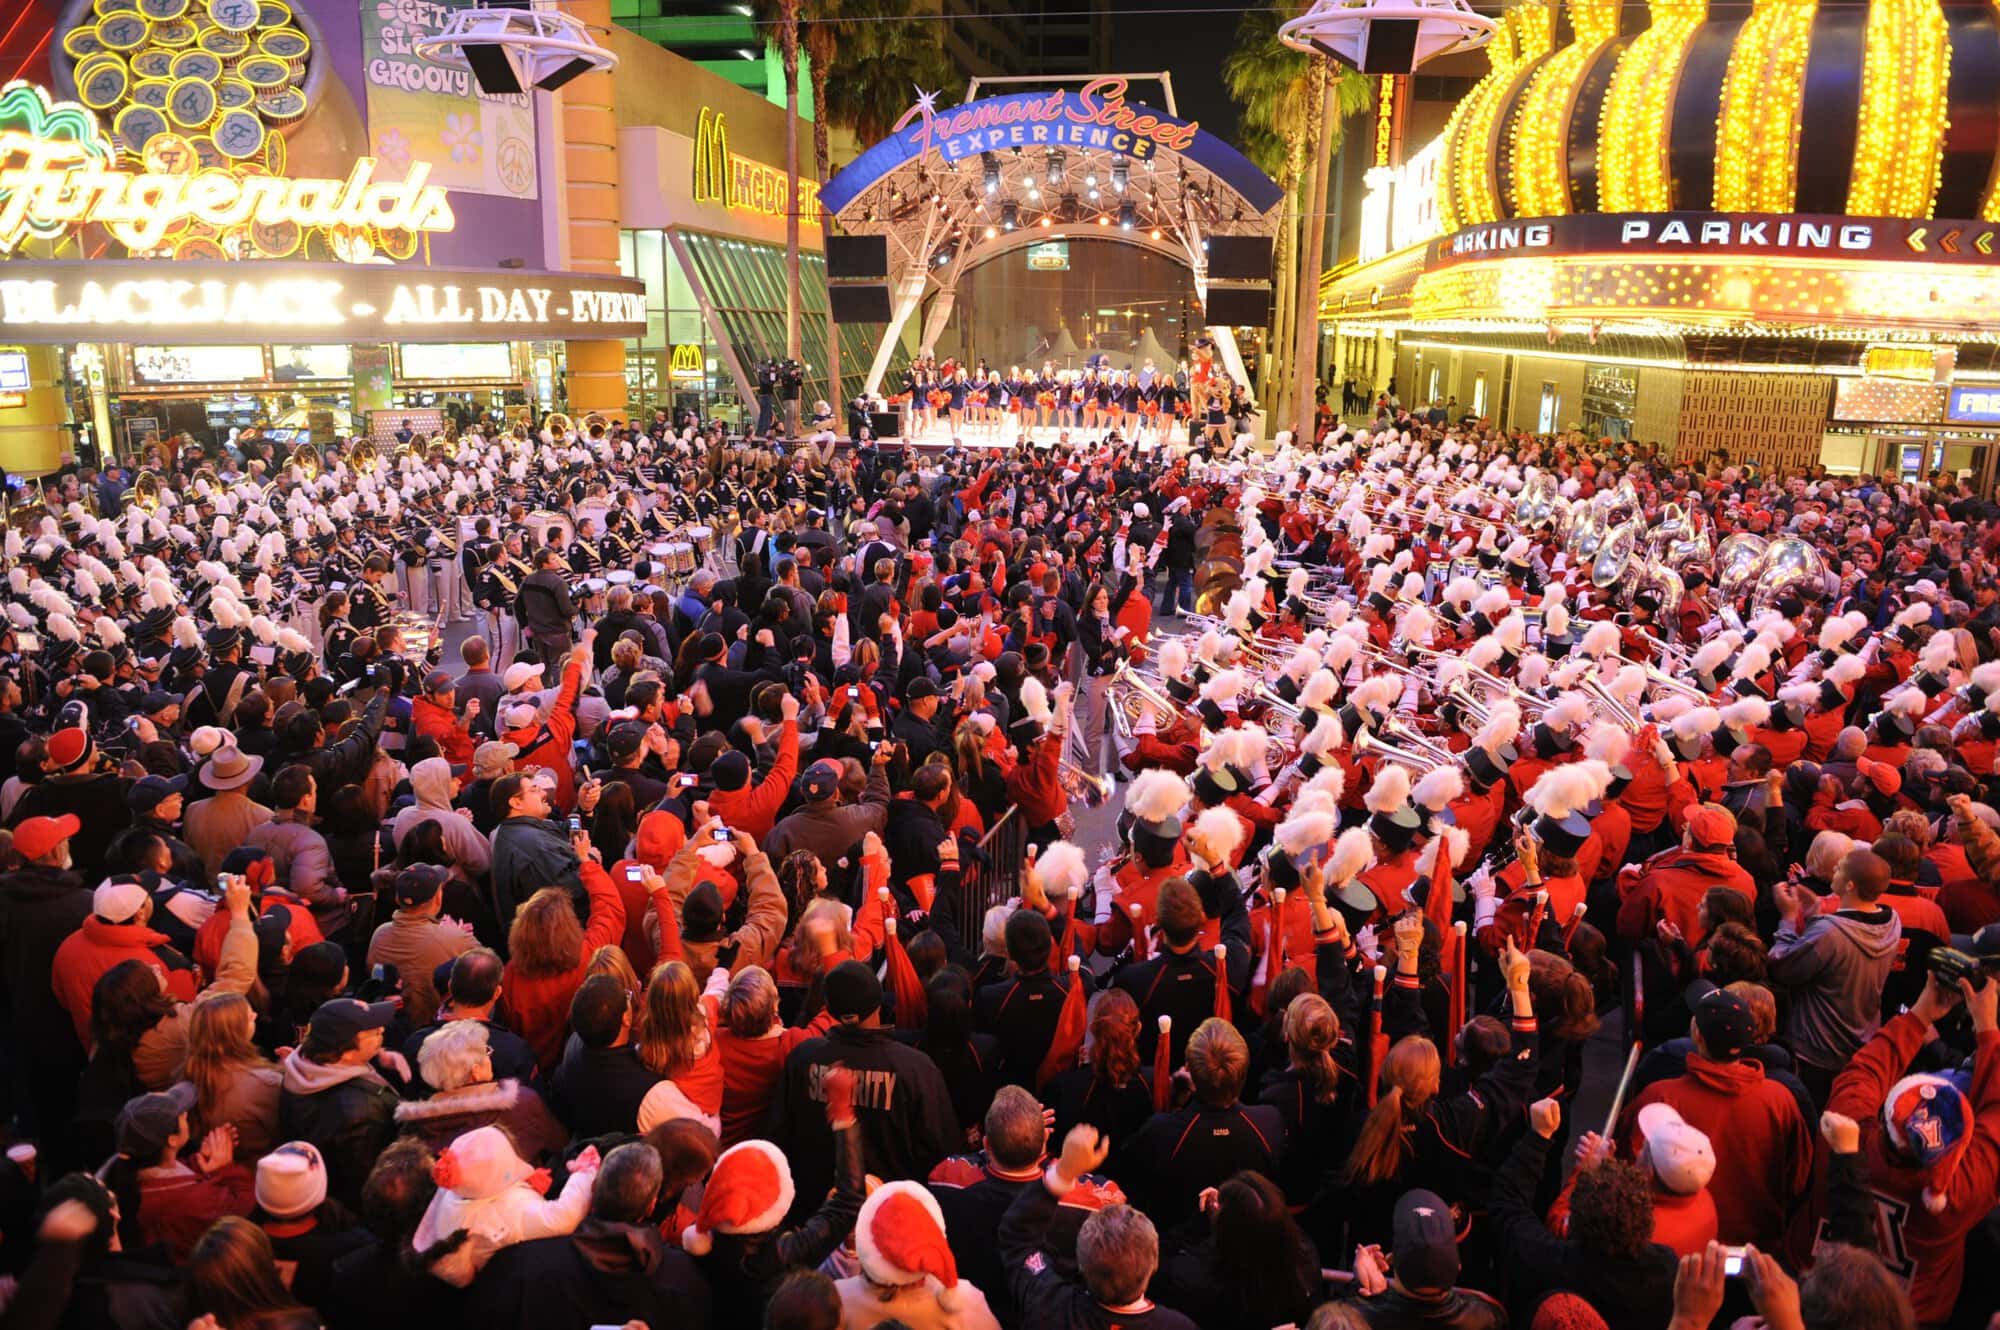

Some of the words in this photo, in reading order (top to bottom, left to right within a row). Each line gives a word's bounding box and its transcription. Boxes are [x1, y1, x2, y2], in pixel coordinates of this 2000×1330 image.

[396, 0, 449, 28] GET
[369, 58, 469, 97] GROOVY
[892, 89, 1066, 165] Fremont
[1065, 77, 1199, 150] Street
[948, 125, 1151, 158] EXPERIENCE
[1621, 220, 1872, 250] PARKING
[0, 280, 346, 324] BLACKJACK
[384, 285, 473, 323] ALL
[477, 287, 552, 322] DAY
[808, 1063, 897, 1111] SERITY
